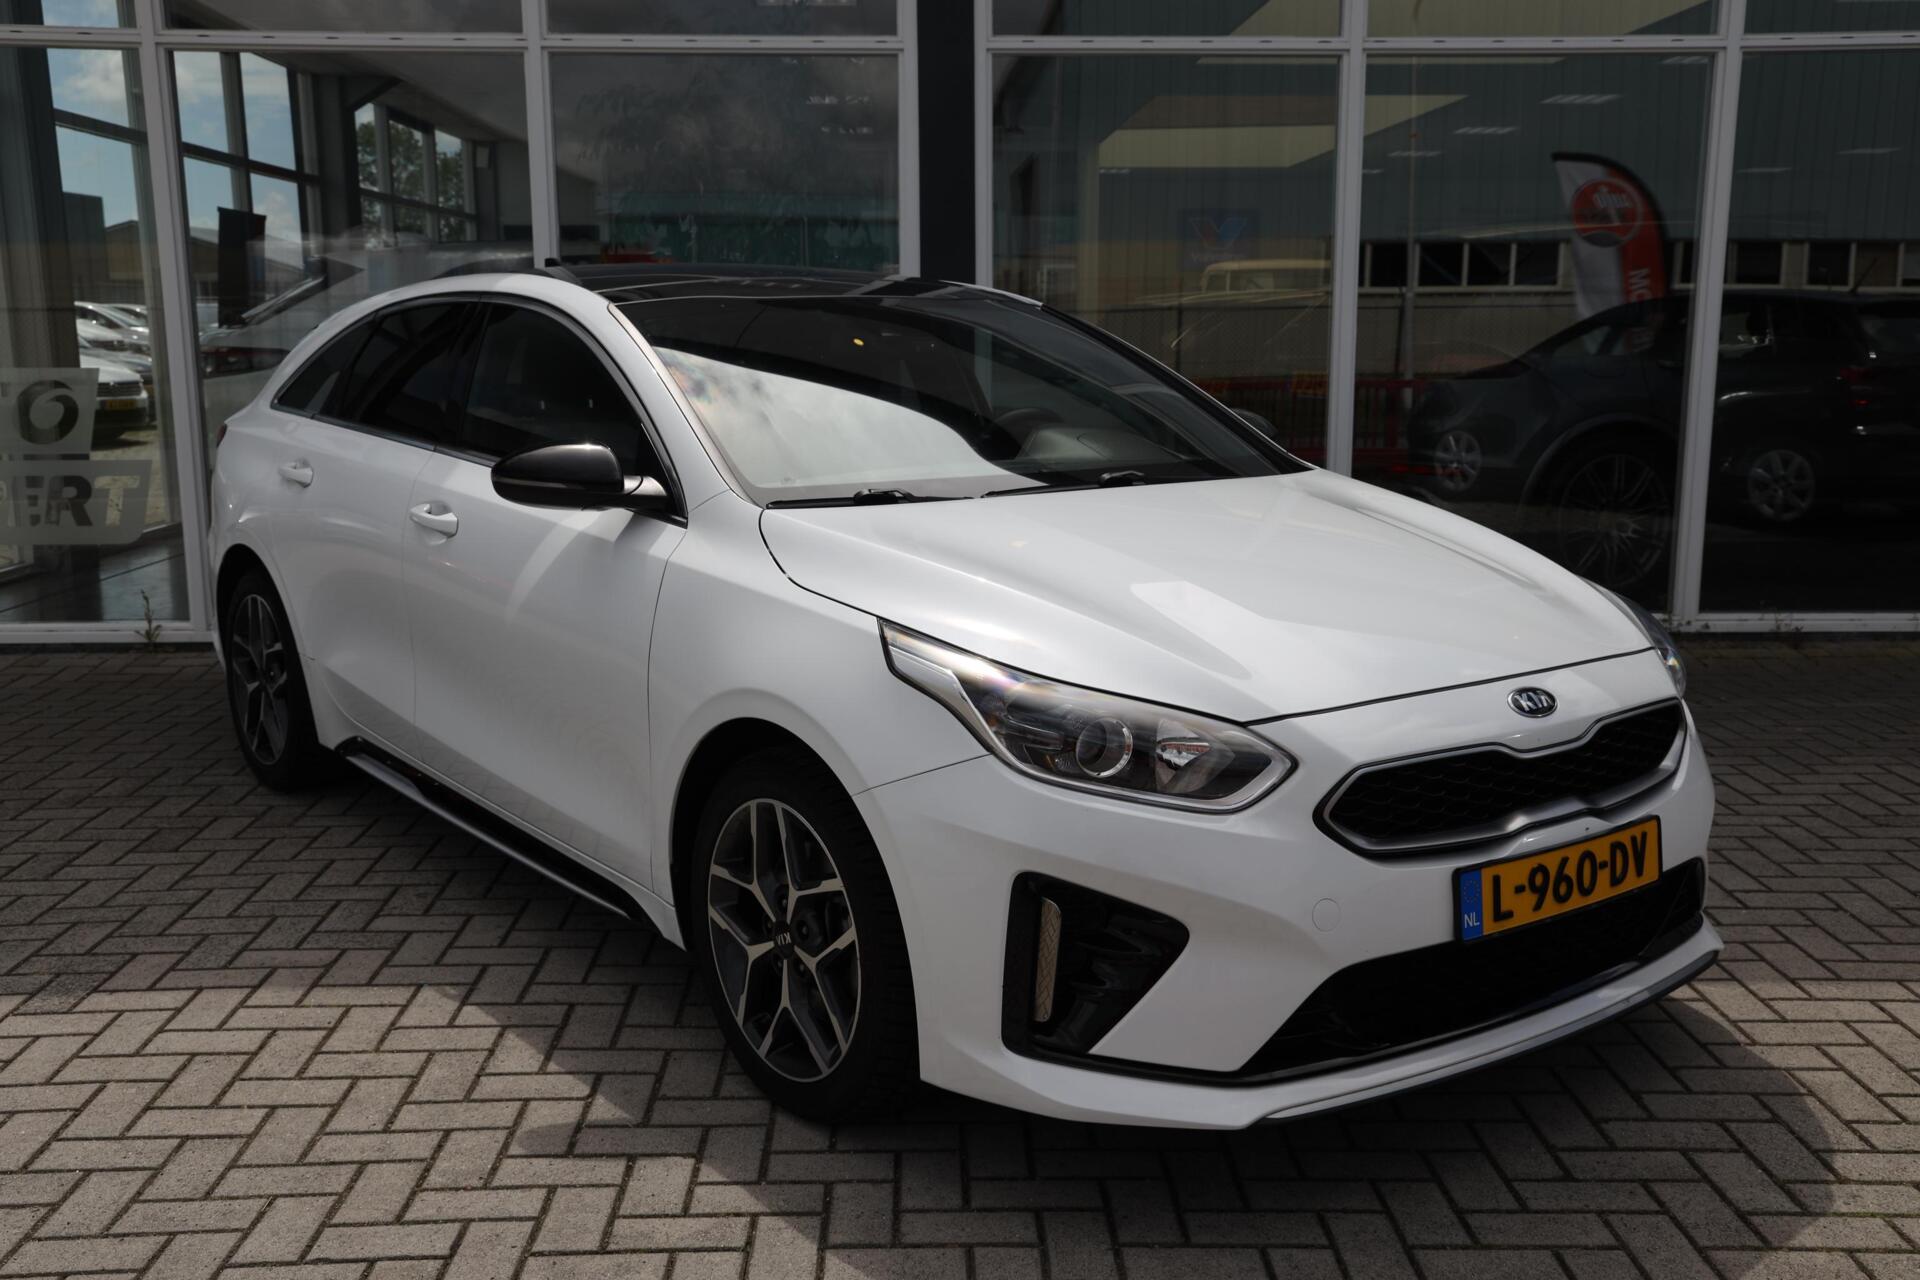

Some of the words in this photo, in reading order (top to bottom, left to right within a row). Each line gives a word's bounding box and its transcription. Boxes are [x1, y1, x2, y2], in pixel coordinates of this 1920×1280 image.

[0, 379, 79, 445] O
[0, 474, 141, 528] ERT
[1514, 691, 1554, 712] KIA
[1492, 831, 1648, 923] L-960-DV
[1464, 911, 1480, 927] NL
[775, 931, 792, 945] KIA
